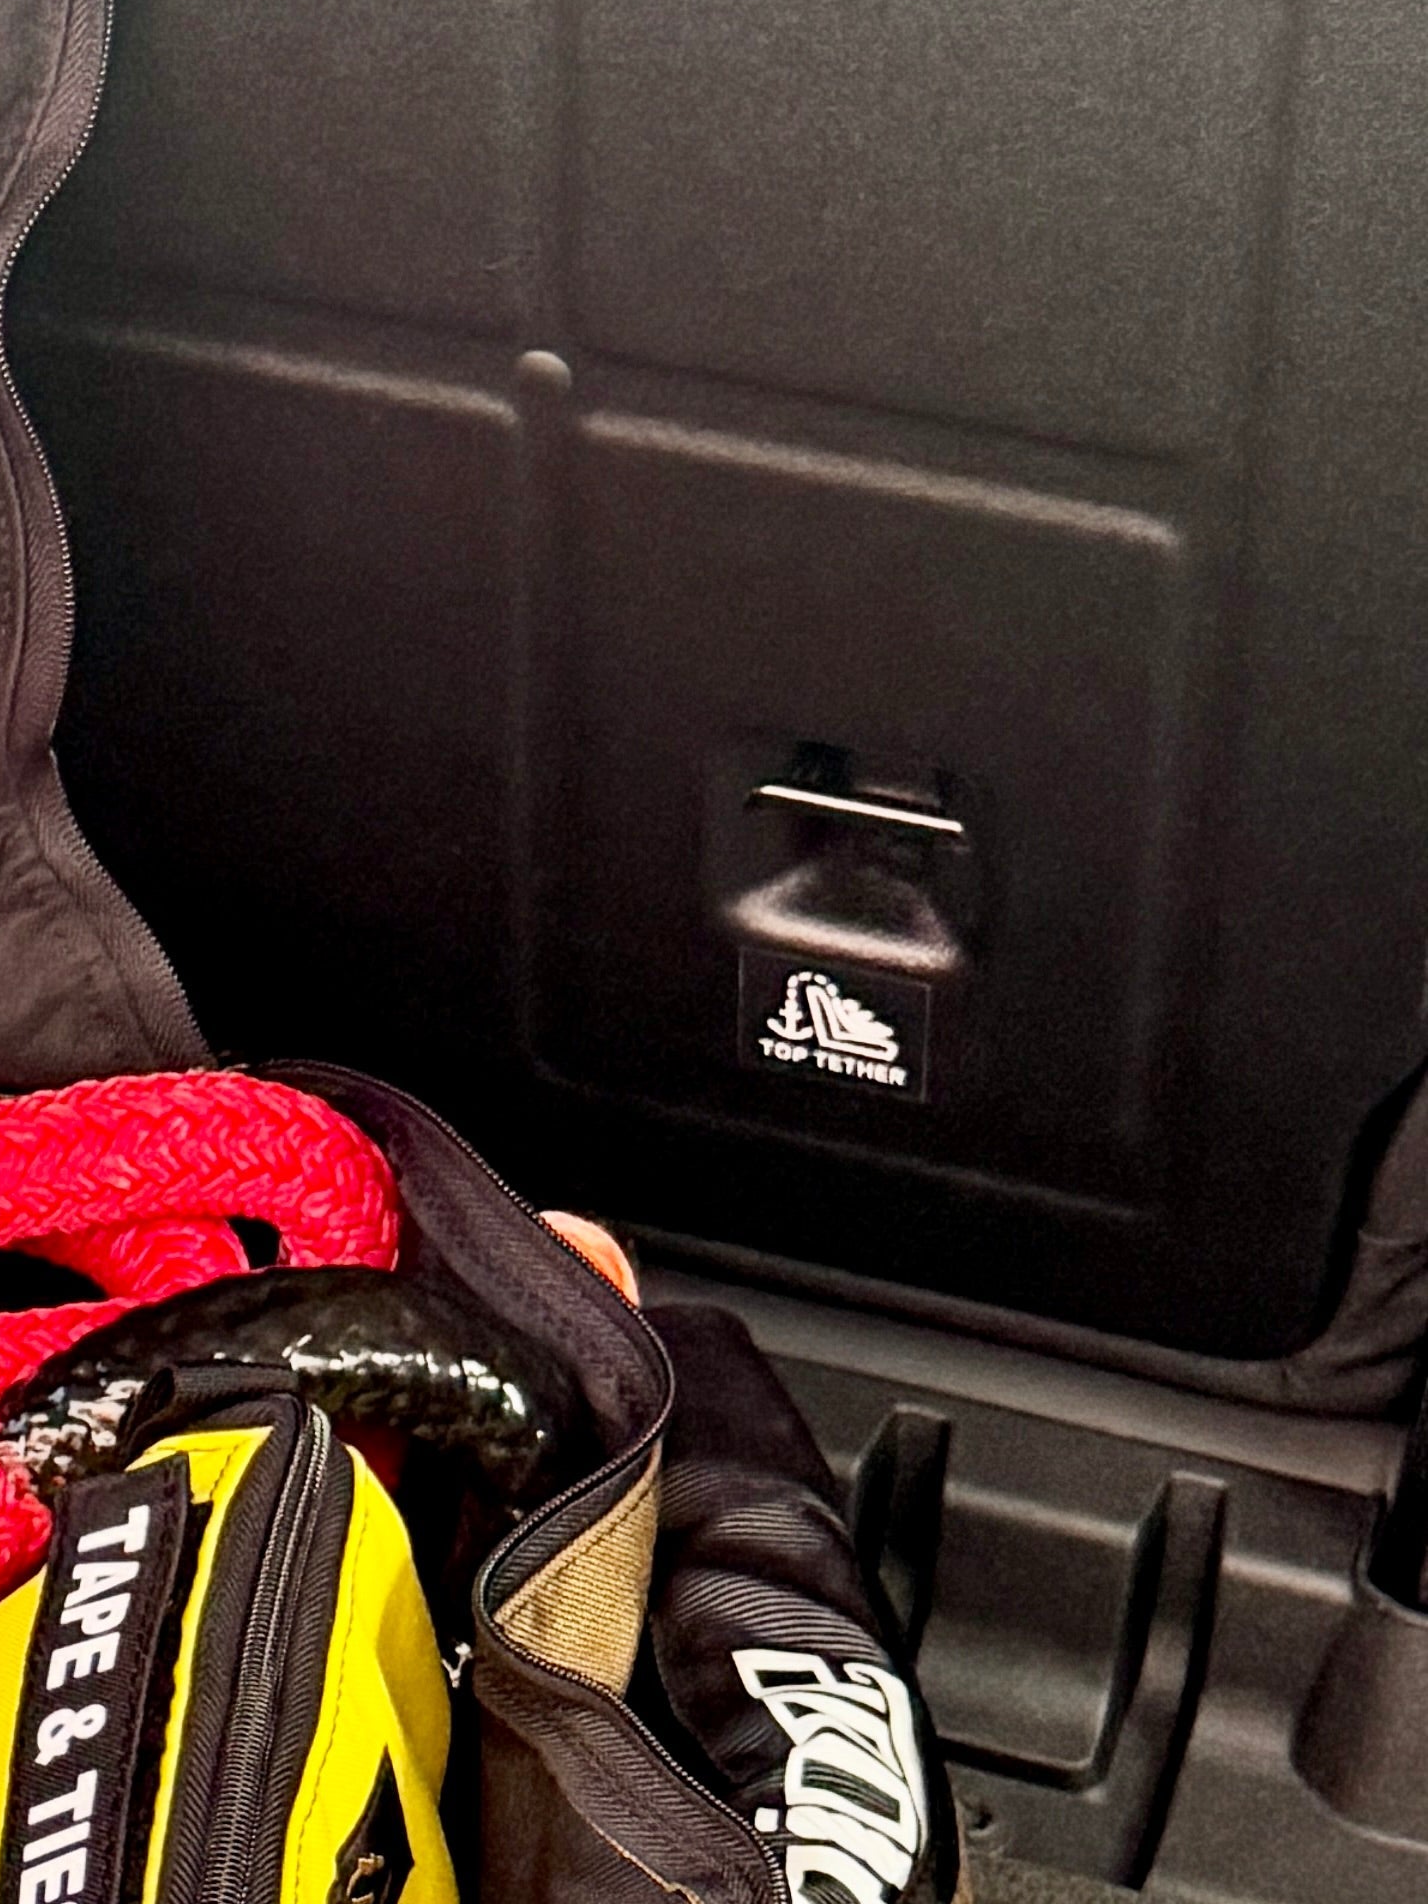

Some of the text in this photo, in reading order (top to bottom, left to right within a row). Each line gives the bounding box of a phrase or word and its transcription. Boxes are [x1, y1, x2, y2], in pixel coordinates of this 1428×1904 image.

[758, 1038, 908, 1086] TOP TETHER
[46, 1504, 151, 1691] TAPE
[34, 1703, 107, 1767] &
